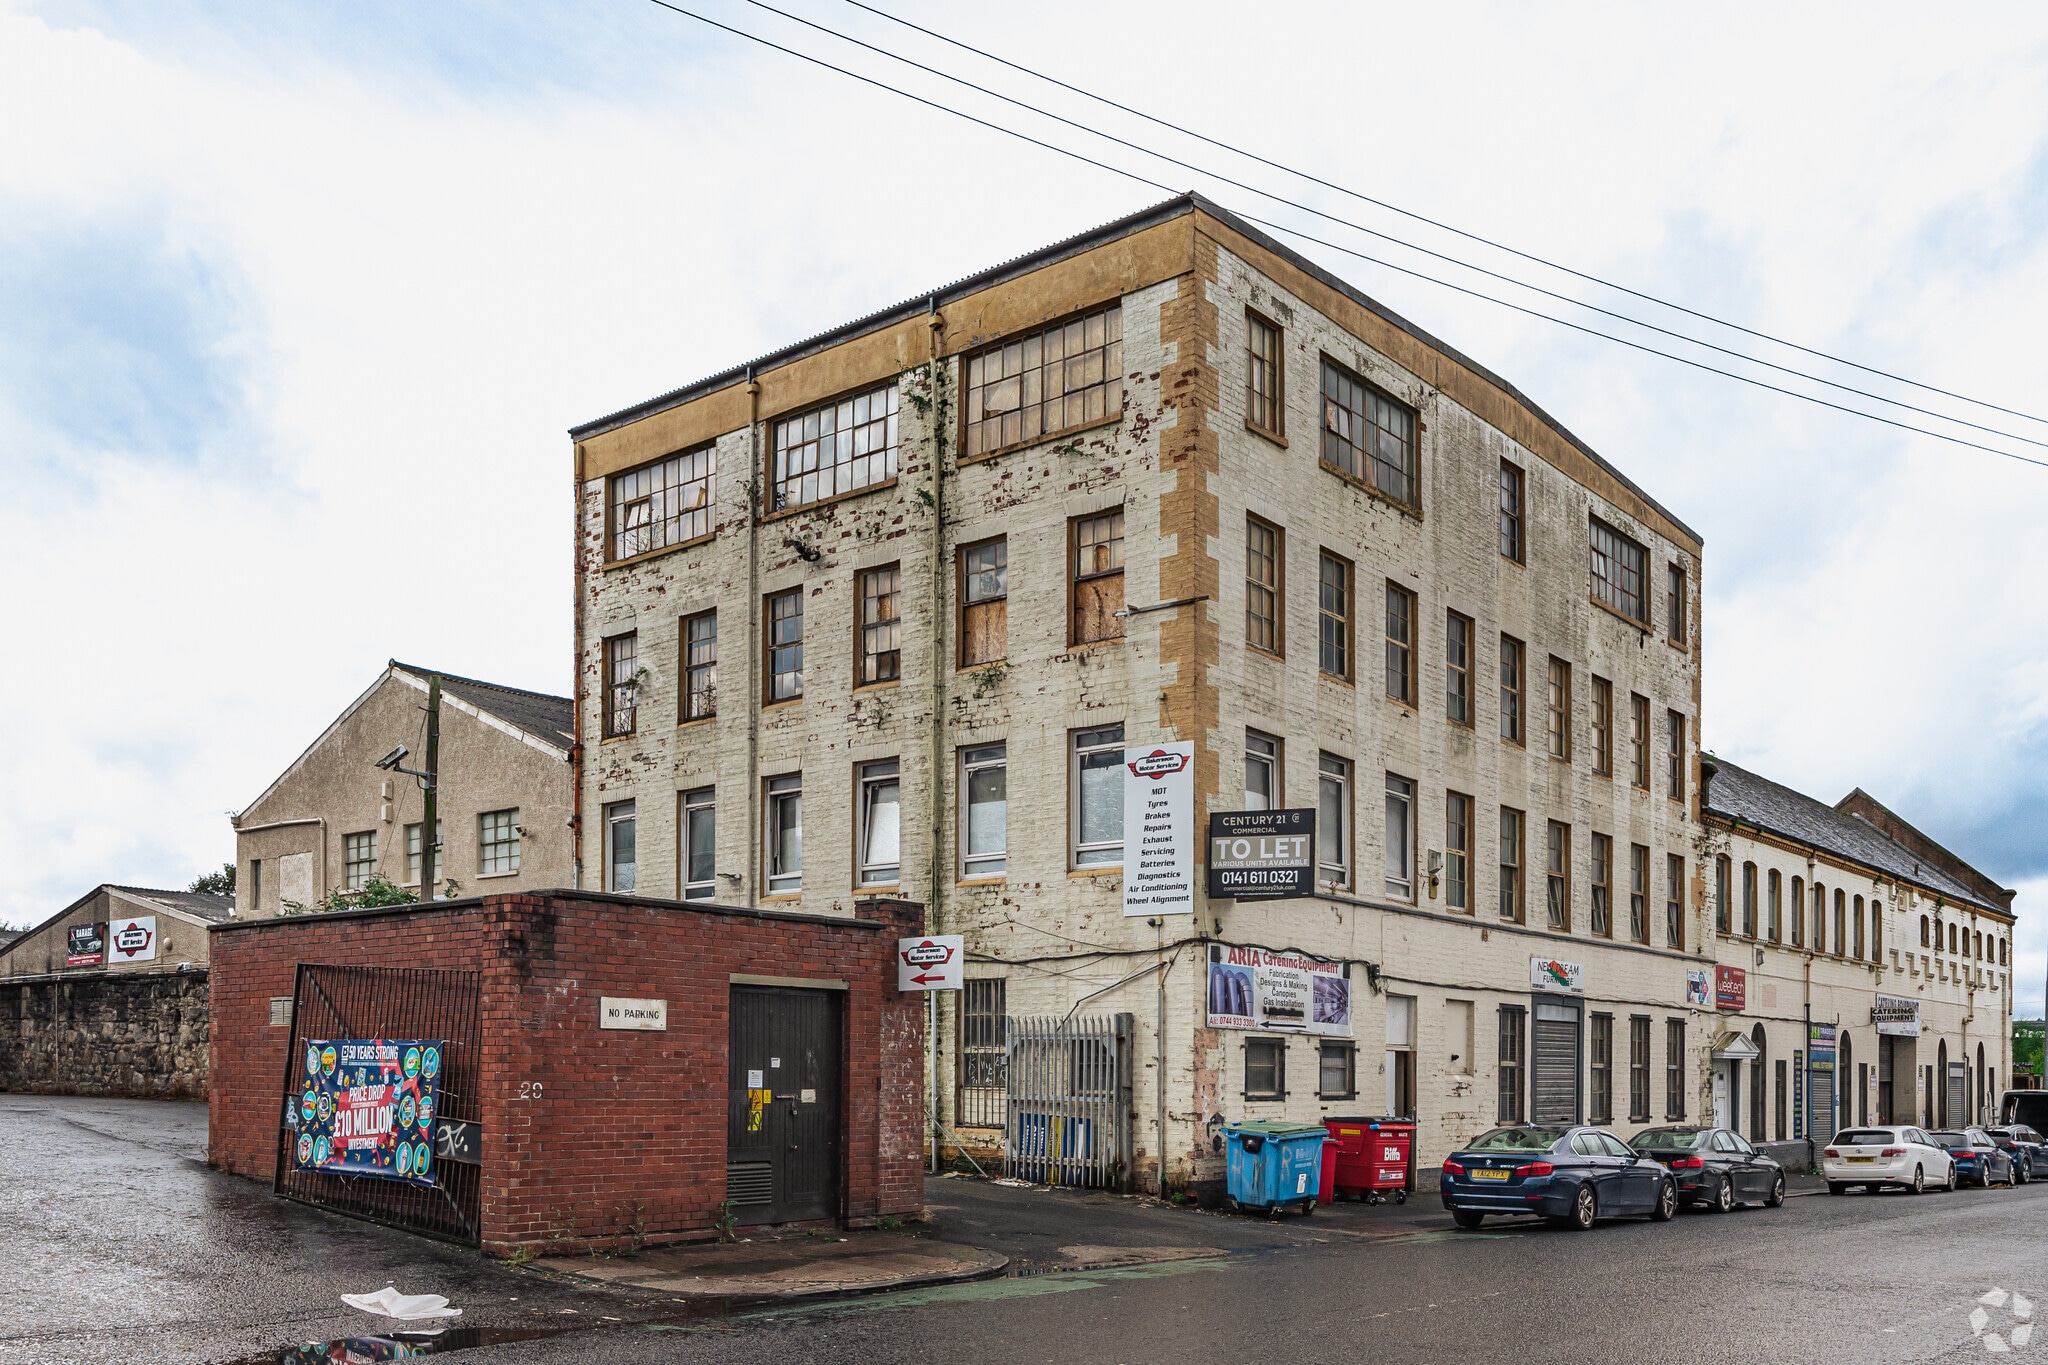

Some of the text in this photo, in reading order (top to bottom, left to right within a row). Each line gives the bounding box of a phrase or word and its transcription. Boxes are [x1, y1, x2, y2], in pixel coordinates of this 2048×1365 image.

[1156, 762, 1179, 770] Services
[1151, 787, 1167, 795] MOT
[1148, 800, 1168, 809] Tyres
[1145, 812, 1170, 820] Brakes
[1222, 815, 1274, 826] CENTURY
[1276, 814, 1286, 824] 21
[1144, 823, 1172, 832] Repairs
[1142, 835, 1172, 844] Exhaust
[1141, 847, 1175, 856] Servicing
[1216, 837, 1306, 860] TO LET
[1140, 859, 1176, 868] Batteries
[1245, 859, 1267, 867] UNITS
[1268, 858, 1308, 867] AVAILABLE
[1137, 871, 1181, 881] Diagnostics
[1221, 870, 1298, 885] 0141 611 0321
[1128, 883, 1188, 893] Air Conditioning
[1126, 895, 1190, 905] Wheel Alignment
[76, 928, 93, 938] GARAGE
[1228, 947, 1339, 974] ARIA Catering Equipment
[1268, 968, 1299, 980] Fabrication
[1260, 977, 1308, 992] Designs & Making
[1718, 980, 1744, 994] weetech
[1271, 989, 1297, 999] Canopies
[1263, 997, 1305, 1009] Gas Installation
[608, 1008, 660, 1019] NO PARKING
[1219, 1016, 1232, 1025] 0744
[1233, 1017, 1242, 1026] 933
[349, 1045, 356, 1059] 50
[357, 1045, 375, 1060] YEARS
[375, 1045, 399, 1060] STRONG
[348, 1084, 386, 1103] PRICE DROP
[333, 1105, 394, 1138] £10 MILLION
[347, 1137, 379, 1150] INVESTMENT
[1384, 1147, 1400, 1161] Biffa
